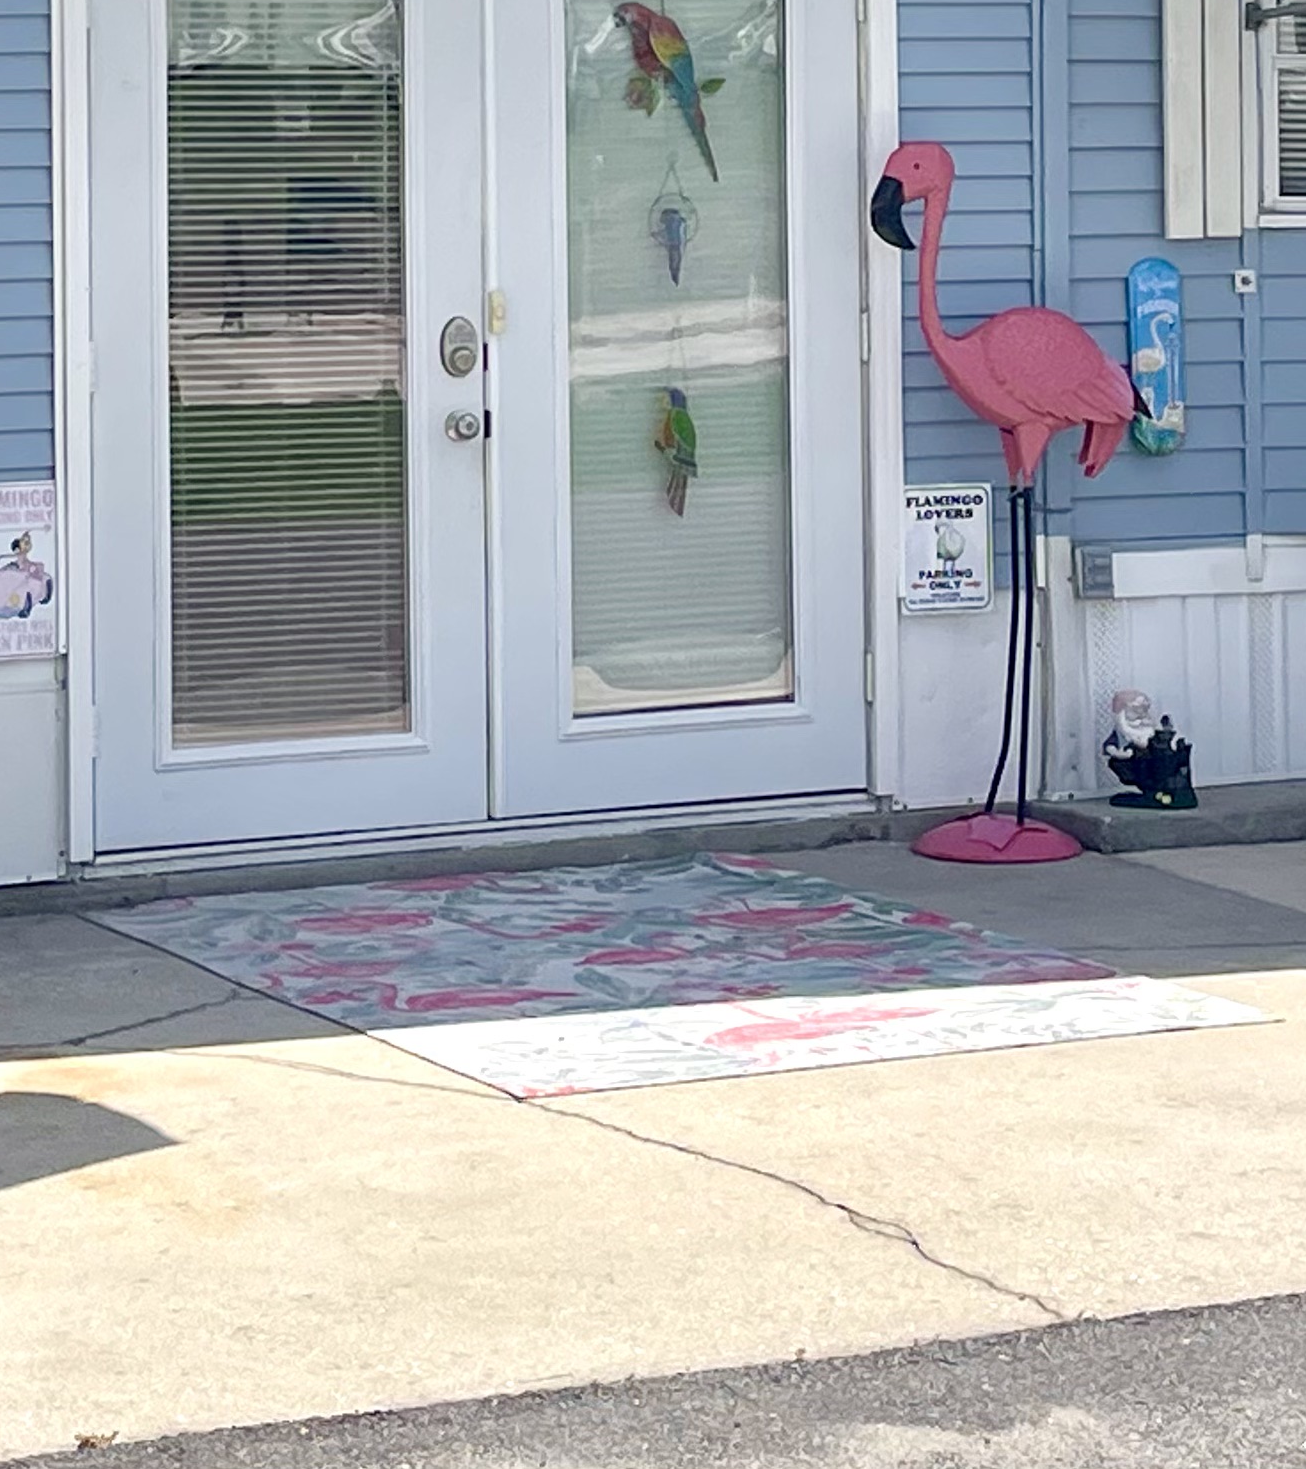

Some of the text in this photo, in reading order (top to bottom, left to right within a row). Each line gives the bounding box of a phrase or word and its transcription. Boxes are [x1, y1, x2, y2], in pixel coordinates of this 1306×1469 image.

[906, 494, 984, 508] FLAMINGO
[915, 508, 974, 521] LOVERS
[919, 568, 973, 579] PARKING
[929, 580, 962, 591] ONLY
[16, 632, 54, 651] PINK
